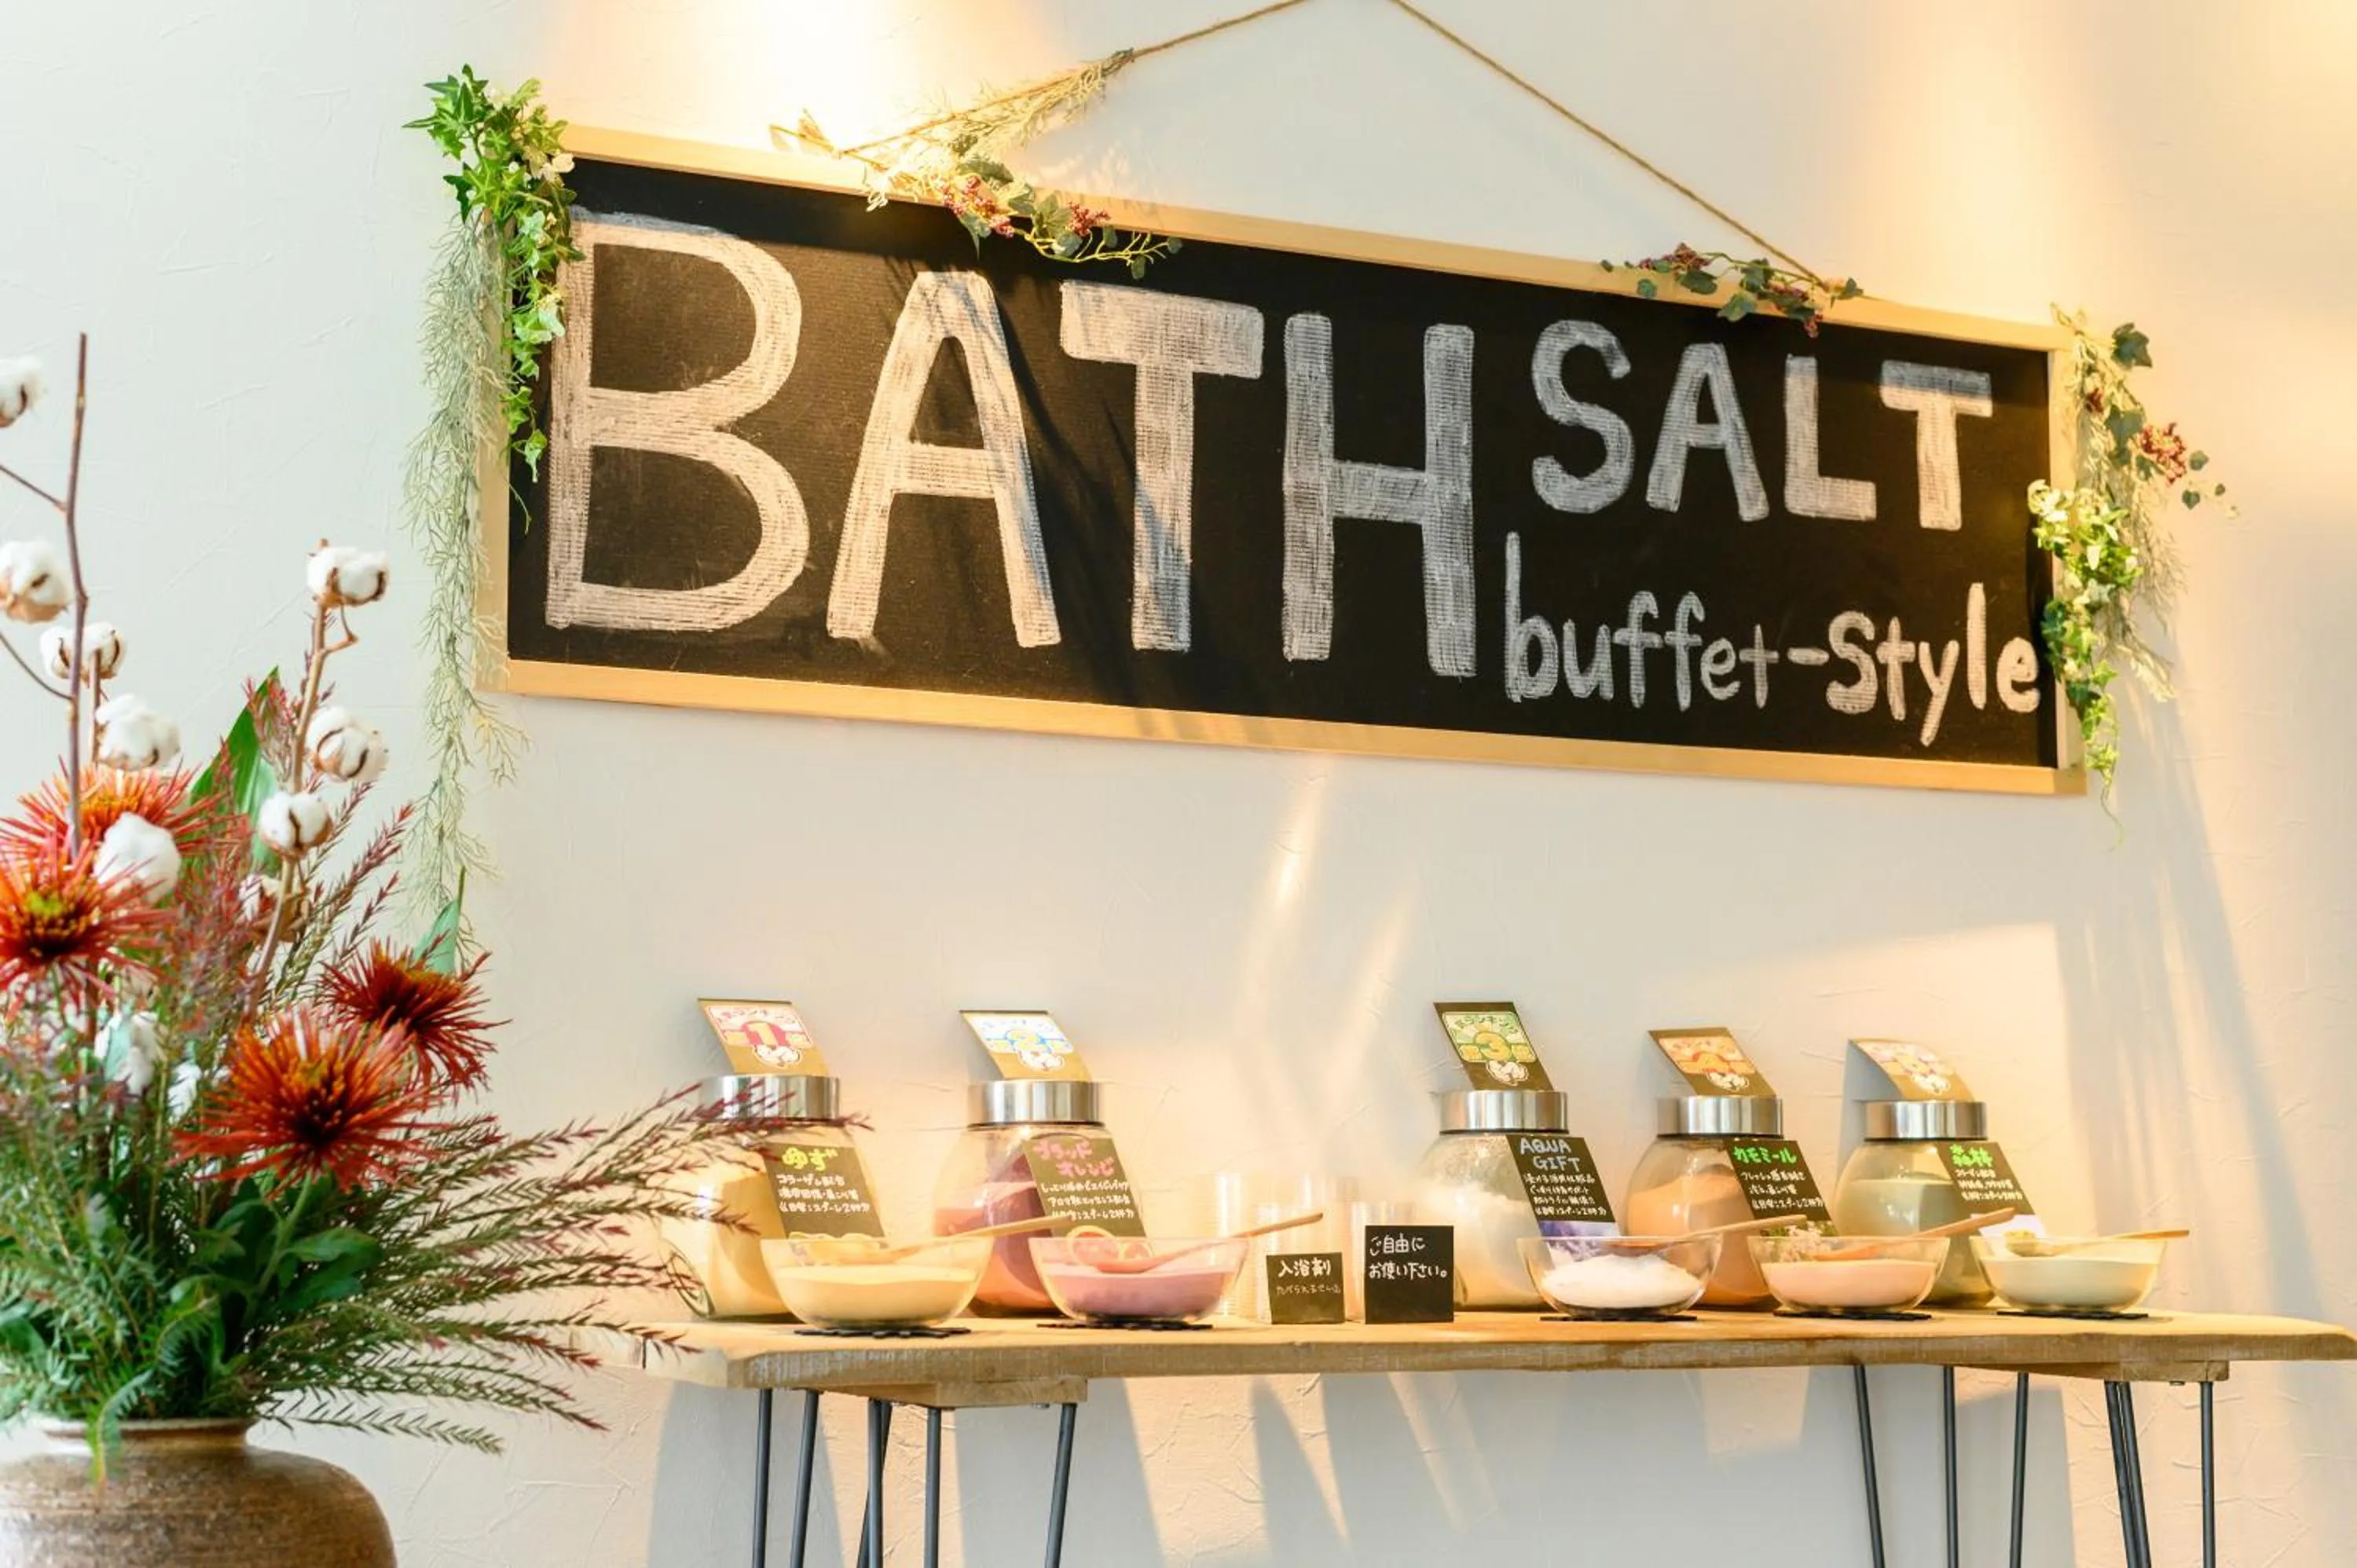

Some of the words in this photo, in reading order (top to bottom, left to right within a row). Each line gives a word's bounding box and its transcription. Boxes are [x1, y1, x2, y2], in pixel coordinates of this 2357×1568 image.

[545, 208, 1477, 677] BATH
[1531, 319, 1993, 531] SALT
[1520, 1138, 1571, 1154] AQUA
[1734, 1146, 1798, 1164] カモミール
[782, 1146, 838, 1171] ゆず
[1533, 1156, 1580, 1172] GIFT
[1369, 1233, 1426, 1255] ご自由に
[1277, 1257, 1332, 1277] 入浴剤
[1369, 1262, 1448, 1280] お使い下さい。
